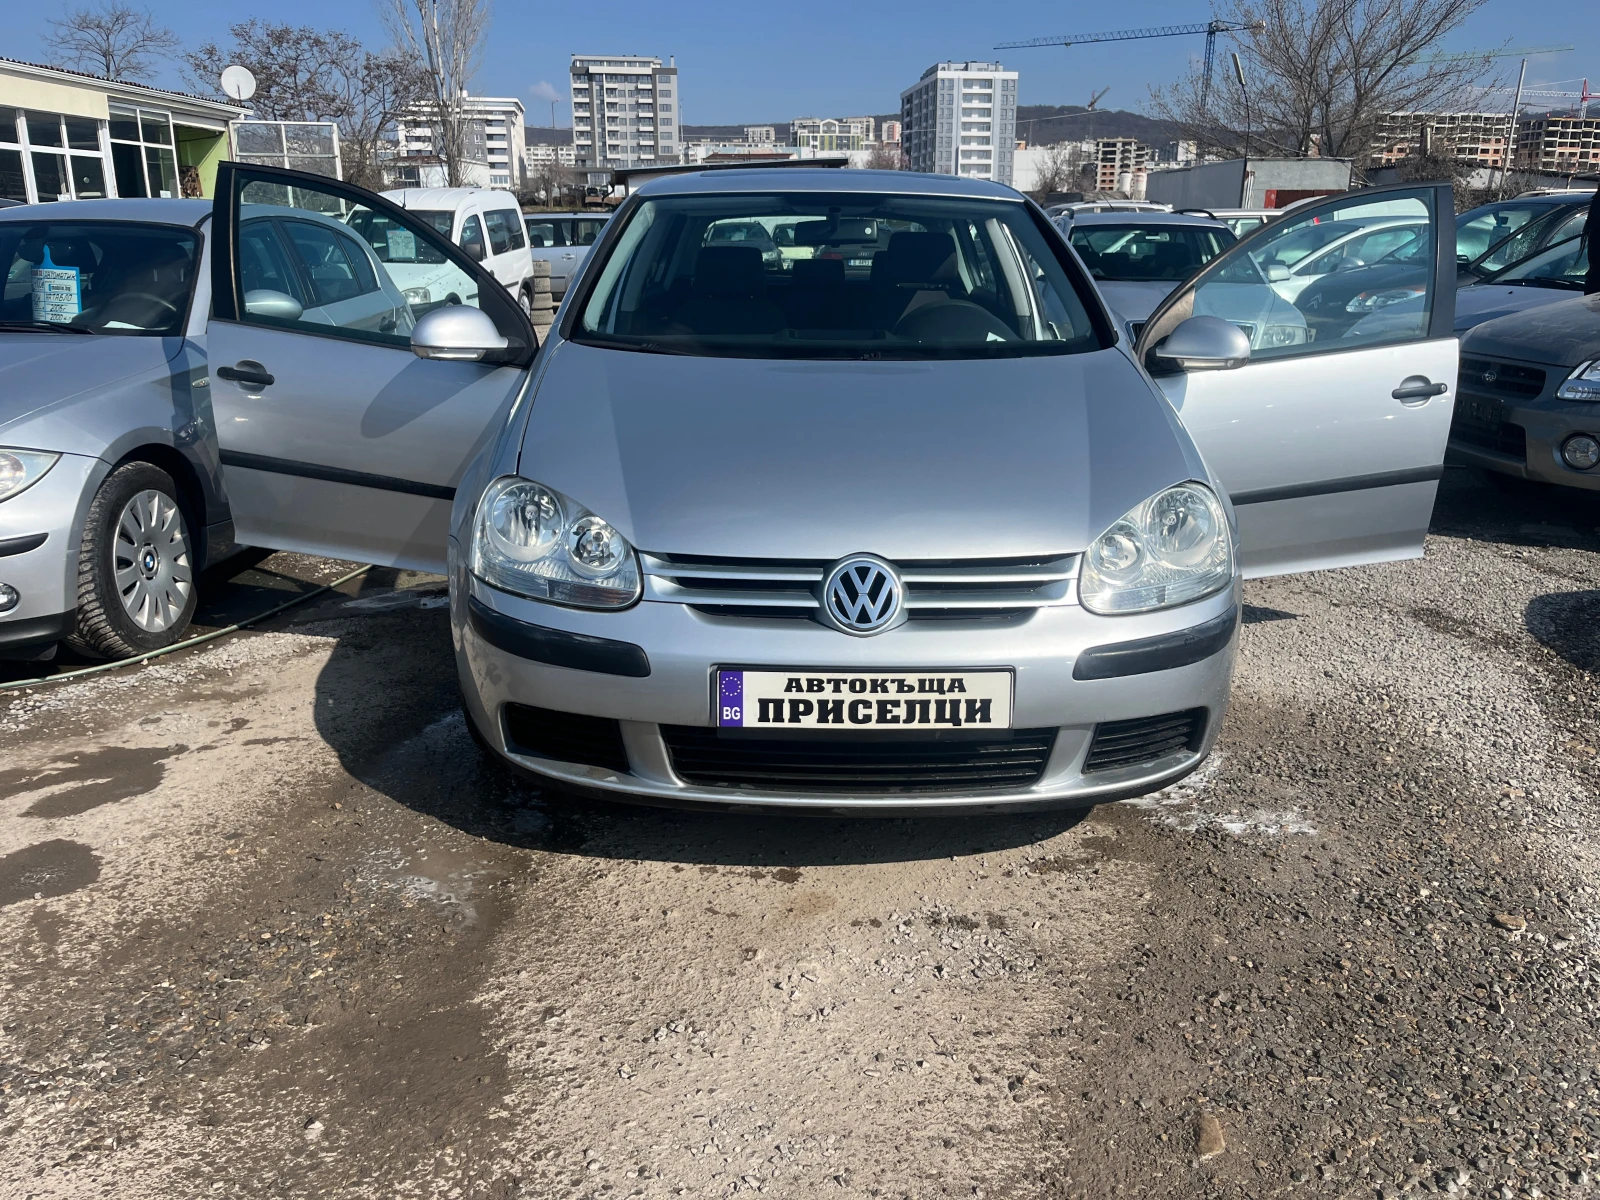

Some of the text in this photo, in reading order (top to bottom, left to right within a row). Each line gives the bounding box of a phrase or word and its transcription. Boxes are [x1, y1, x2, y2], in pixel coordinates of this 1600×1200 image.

[784, 677, 966, 695] АВТОКЪЩА
[723, 706, 741, 720] BG
[758, 698, 992, 726] ПРИСЕЛЦИ
